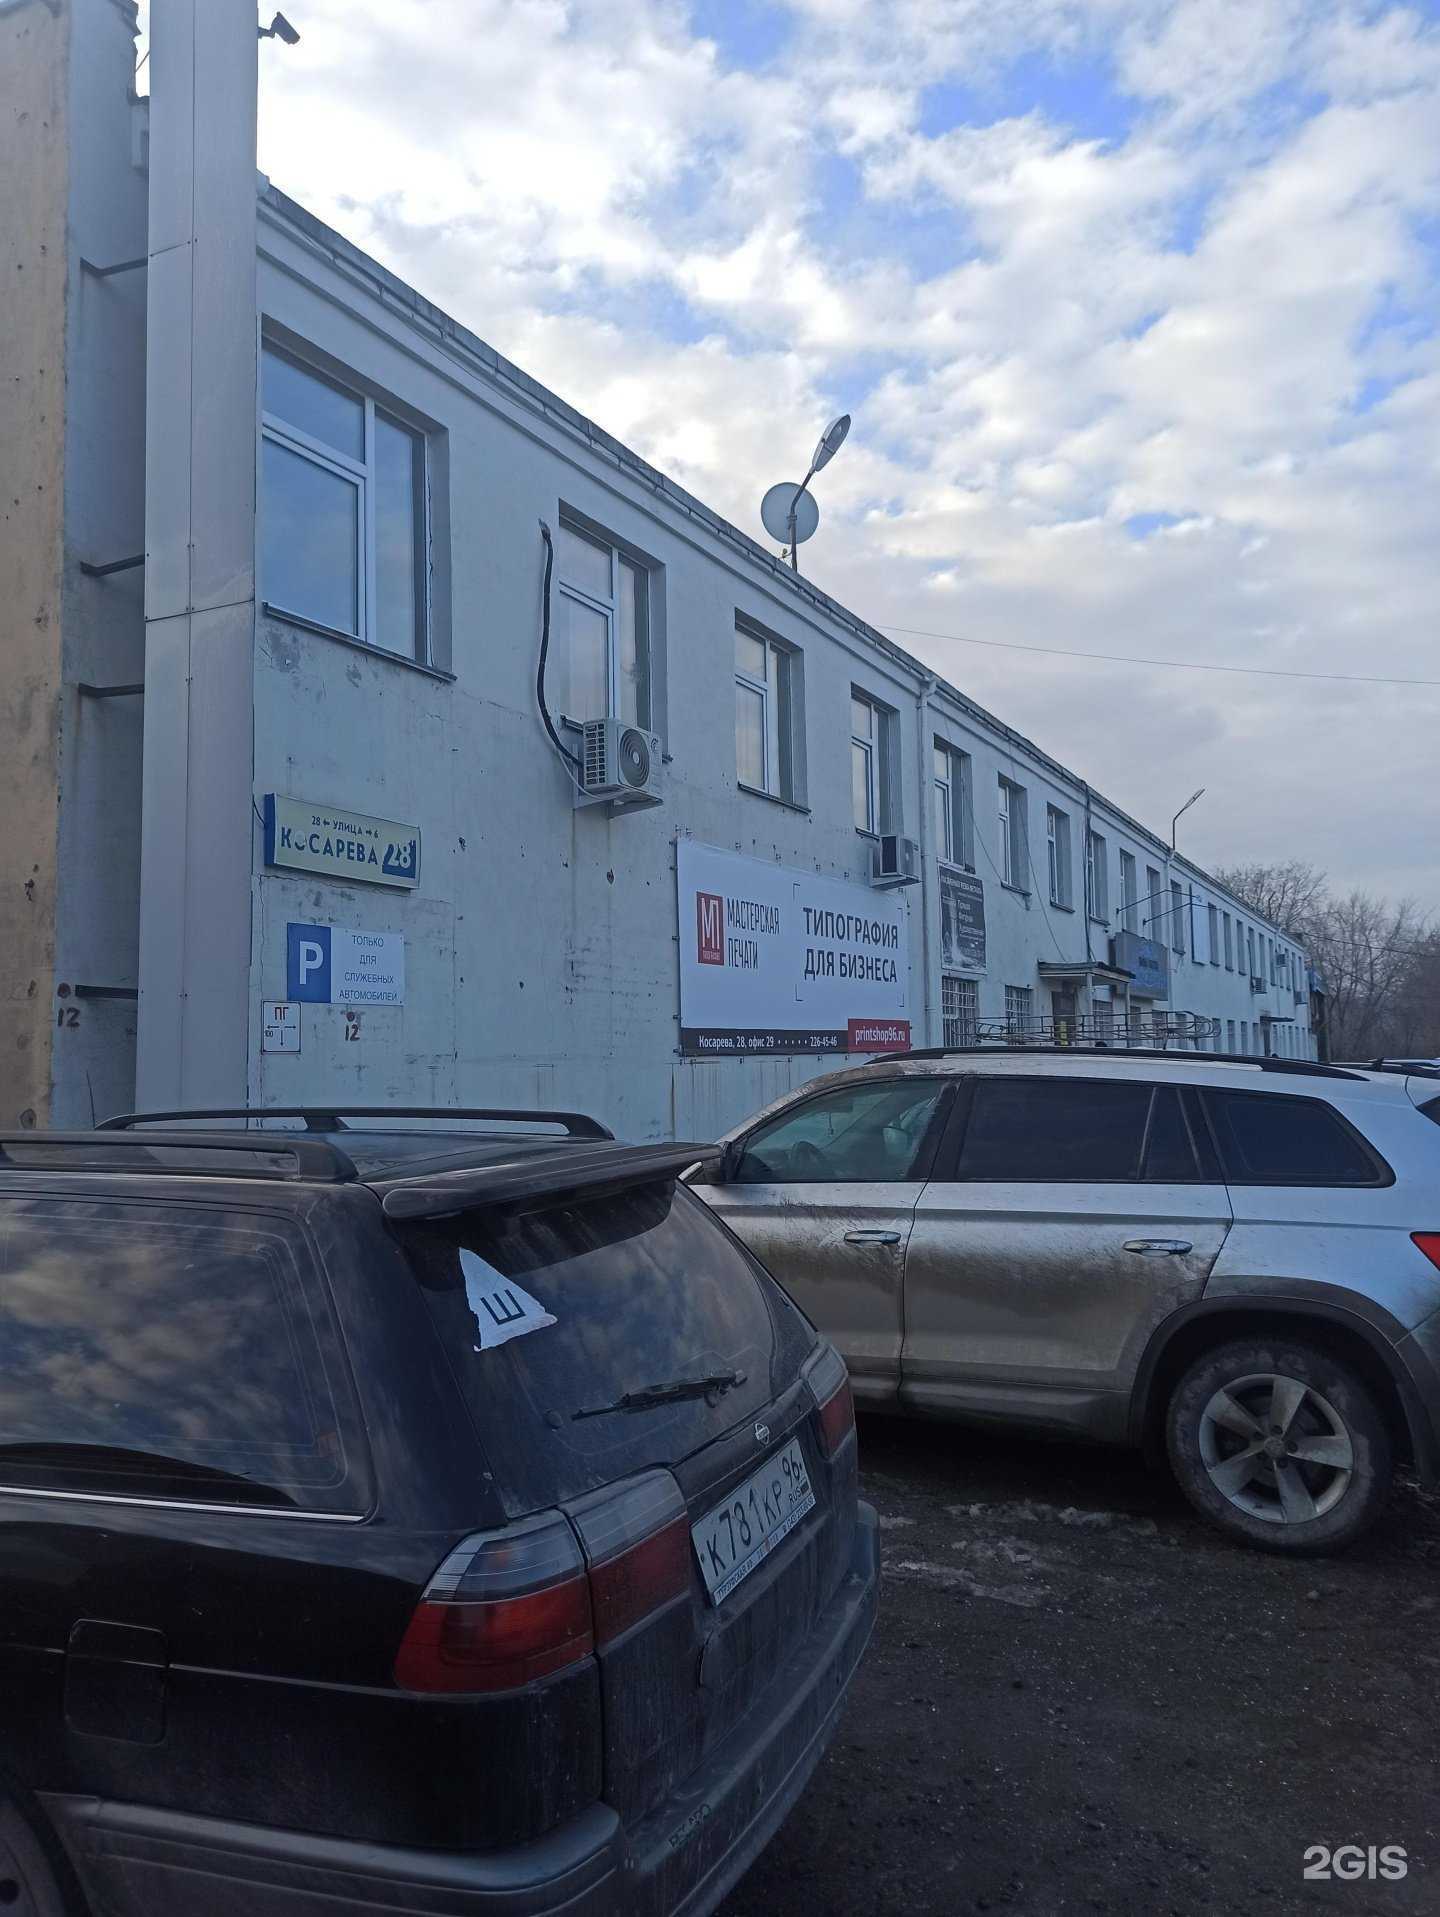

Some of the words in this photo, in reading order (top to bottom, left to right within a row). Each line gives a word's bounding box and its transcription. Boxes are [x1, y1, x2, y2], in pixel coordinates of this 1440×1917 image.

[311, 815, 321, 826] 28
[332, 820, 362, 836] УЛИЦА
[383, 843, 412, 869] 28
[727, 898, 780, 935] МАСТЕРСКАЯ
[803, 907, 898, 948] ТИПОГРАФИЯ
[352, 935, 384, 948] ТОЛЬКО
[359, 954, 377, 966] ДЛЯ
[728, 938, 759, 969] ПЕЧАТИ
[804, 948, 835, 981] ДЛЯ
[839, 952, 898, 983] БИЗНЕСА
[344, 971, 394, 984] СЛУЖЕБНЫХ
[339, 989, 398, 1001] АВТОМОБИЛЕЙ
[57, 1007, 80, 1028] 12
[274, 1006, 289, 1021] ПГ
[345, 1024, 361, 1042] 12
[698, 1035, 735, 1051] Косарева,
[736, 1036, 747, 1049] 28,
[748, 1035, 765, 1051] офис
[765, 1036, 774, 1047] 29
[810, 1036, 838, 1048] 226-45-46
[855, 1026, 906, 1045] printshop96.ru
[480, 1289, 526, 1326] Ш
[782, 1450, 801, 1488] 96
[788, 1487, 802, 1505] RUS
